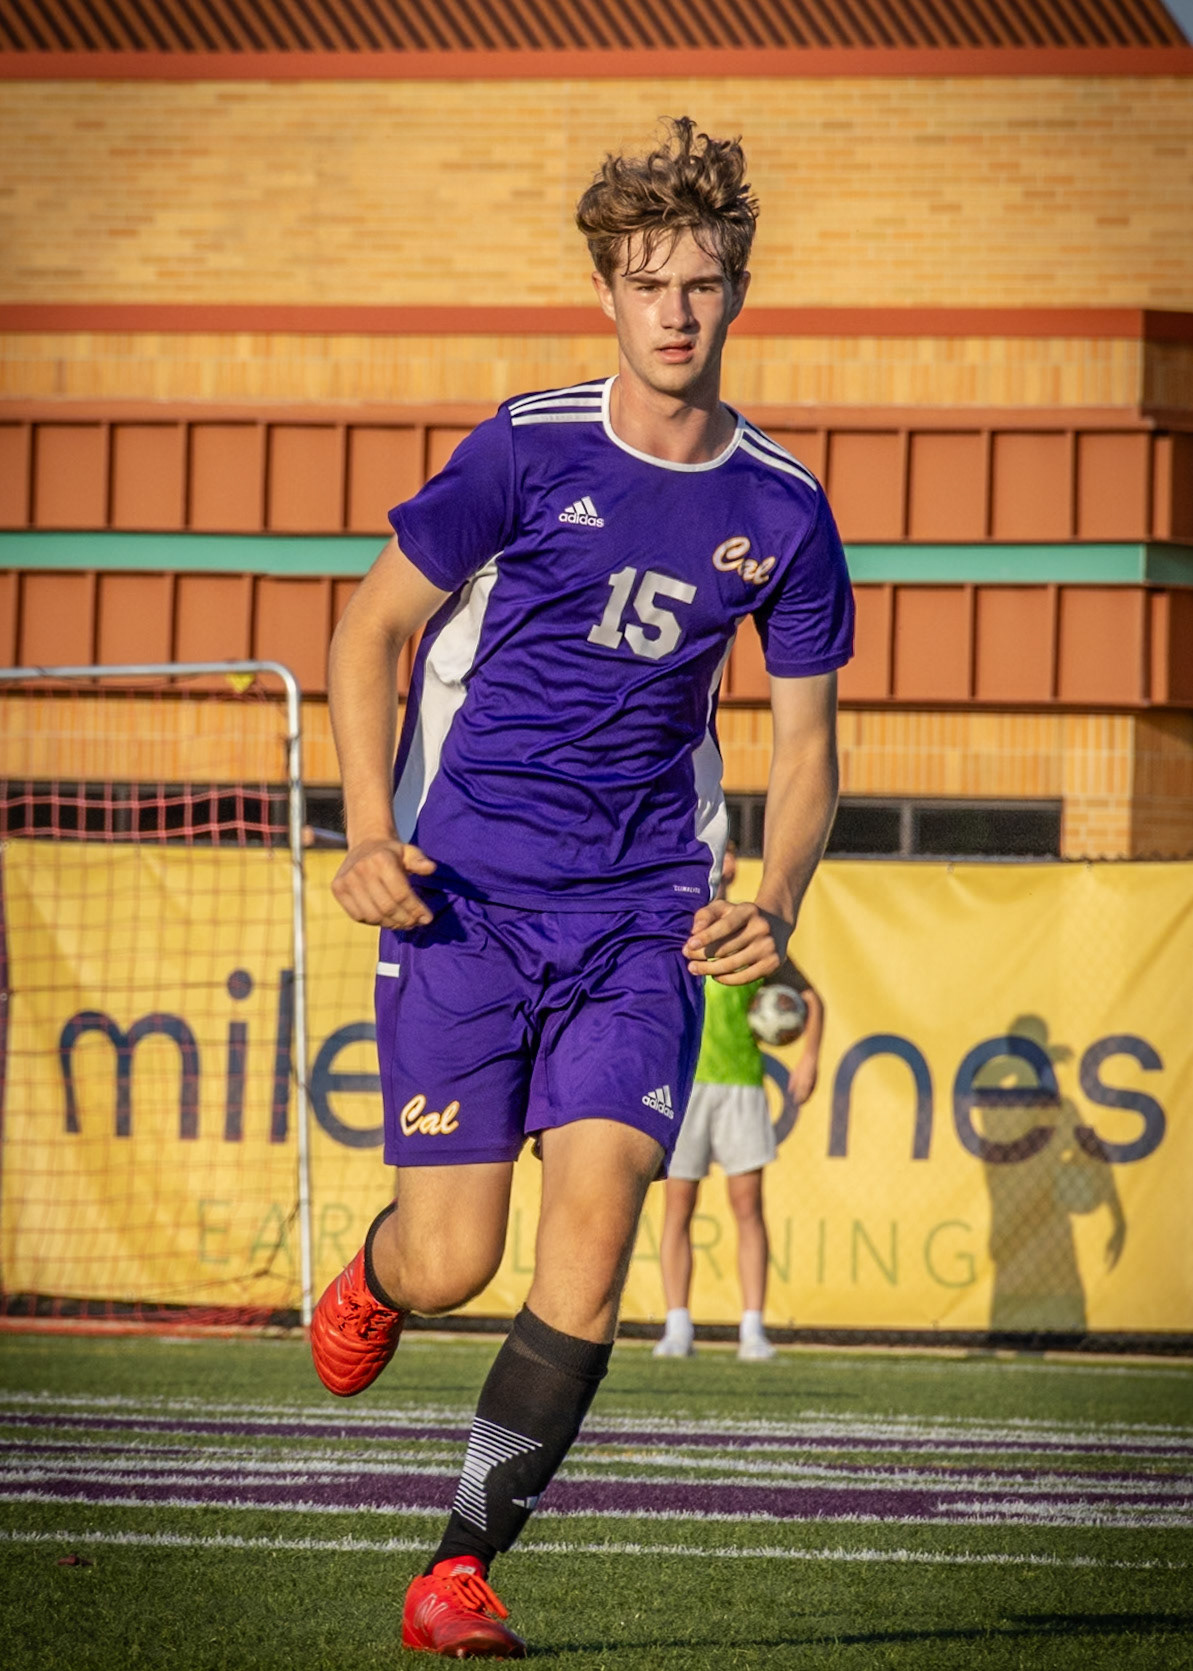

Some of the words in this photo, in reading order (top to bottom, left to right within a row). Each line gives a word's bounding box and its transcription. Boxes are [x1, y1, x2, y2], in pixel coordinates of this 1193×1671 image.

[558, 511, 604, 528] adidas
[587, 566, 697, 660] 15
[59, 968, 1167, 1164] milenes
[400, 1093, 460, 1137] Cal
[641, 1094, 675, 1120] adidas
